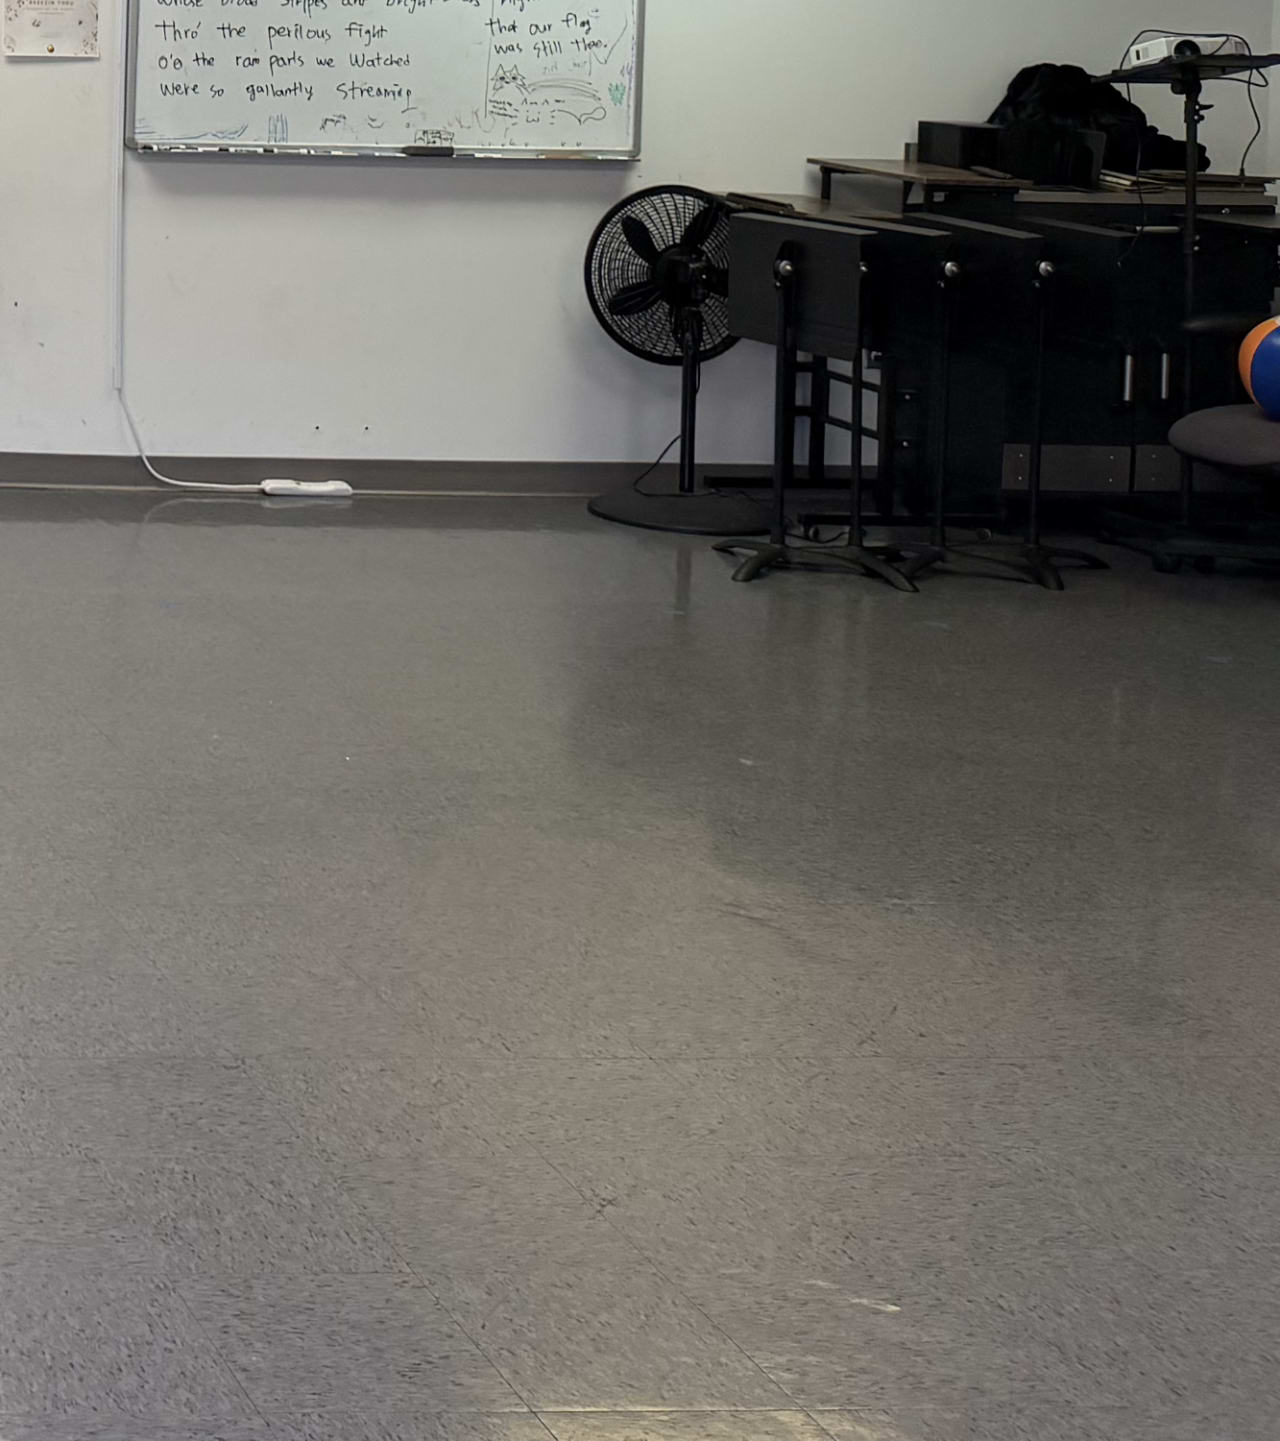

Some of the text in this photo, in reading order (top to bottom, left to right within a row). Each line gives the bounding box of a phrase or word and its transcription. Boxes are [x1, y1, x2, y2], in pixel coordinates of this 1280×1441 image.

[529, 22, 552, 35] our
[216, 22, 247, 39] the
[268, 22, 332, 50] perilous
[494, 43, 523, 55] was
[192, 52, 215, 67] the
[316, 55, 336, 68] we
